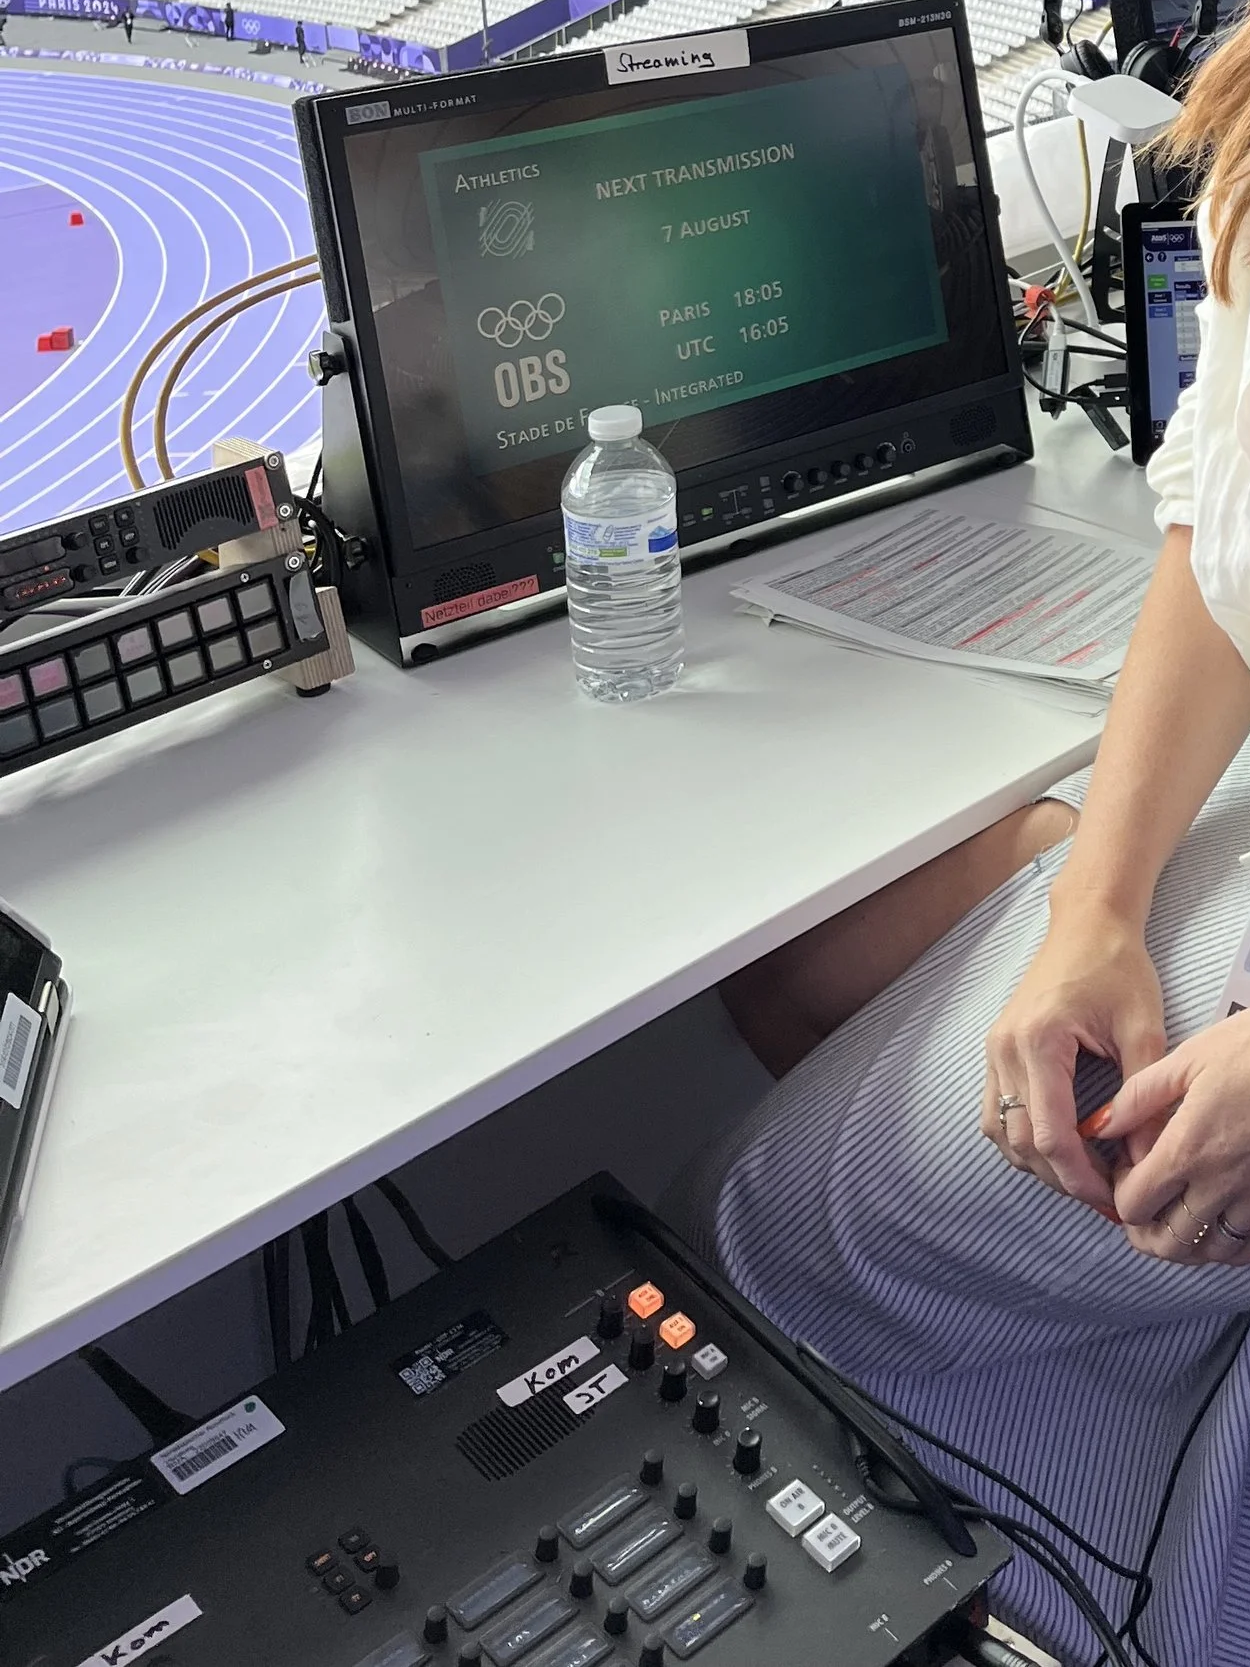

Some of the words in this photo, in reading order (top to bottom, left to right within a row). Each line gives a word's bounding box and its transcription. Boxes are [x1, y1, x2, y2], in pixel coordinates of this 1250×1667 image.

[617, 49, 716, 74] Streaming
[393, 94, 477, 117] MULTI-FORMAT
[595, 174, 648, 201] NEXT
[652, 142, 796, 188] TRANSMISSION
[660, 225, 673, 244] 7
[680, 209, 751, 240] AUGUST
[659, 301, 710, 327] PARIS
[733, 281, 784, 309] 18:05
[677, 336, 716, 360] UTC
[738, 316, 789, 344] 16:05
[494, 349, 570, 408] OBS
[497, 421, 550, 449] STADE
[655, 370, 744, 406] INTEGRATED
[425, 599, 474, 623] Netzteil
[524, 1354, 579, 1394] Kom
[748, 1471, 771, 1490] PHONES
[780, 1497, 791, 1509] ON
[790, 1487, 806, 1502] AIR
[843, 1494, 867, 1517] OUTPUT
[851, 1507, 868, 1524] LEVEL
[816, 1527, 832, 1542] MIC
[827, 1532, 848, 1550] MUTE
[0, 1549, 50, 1586] NDR
[101, 1620, 169, 1666] Kom
